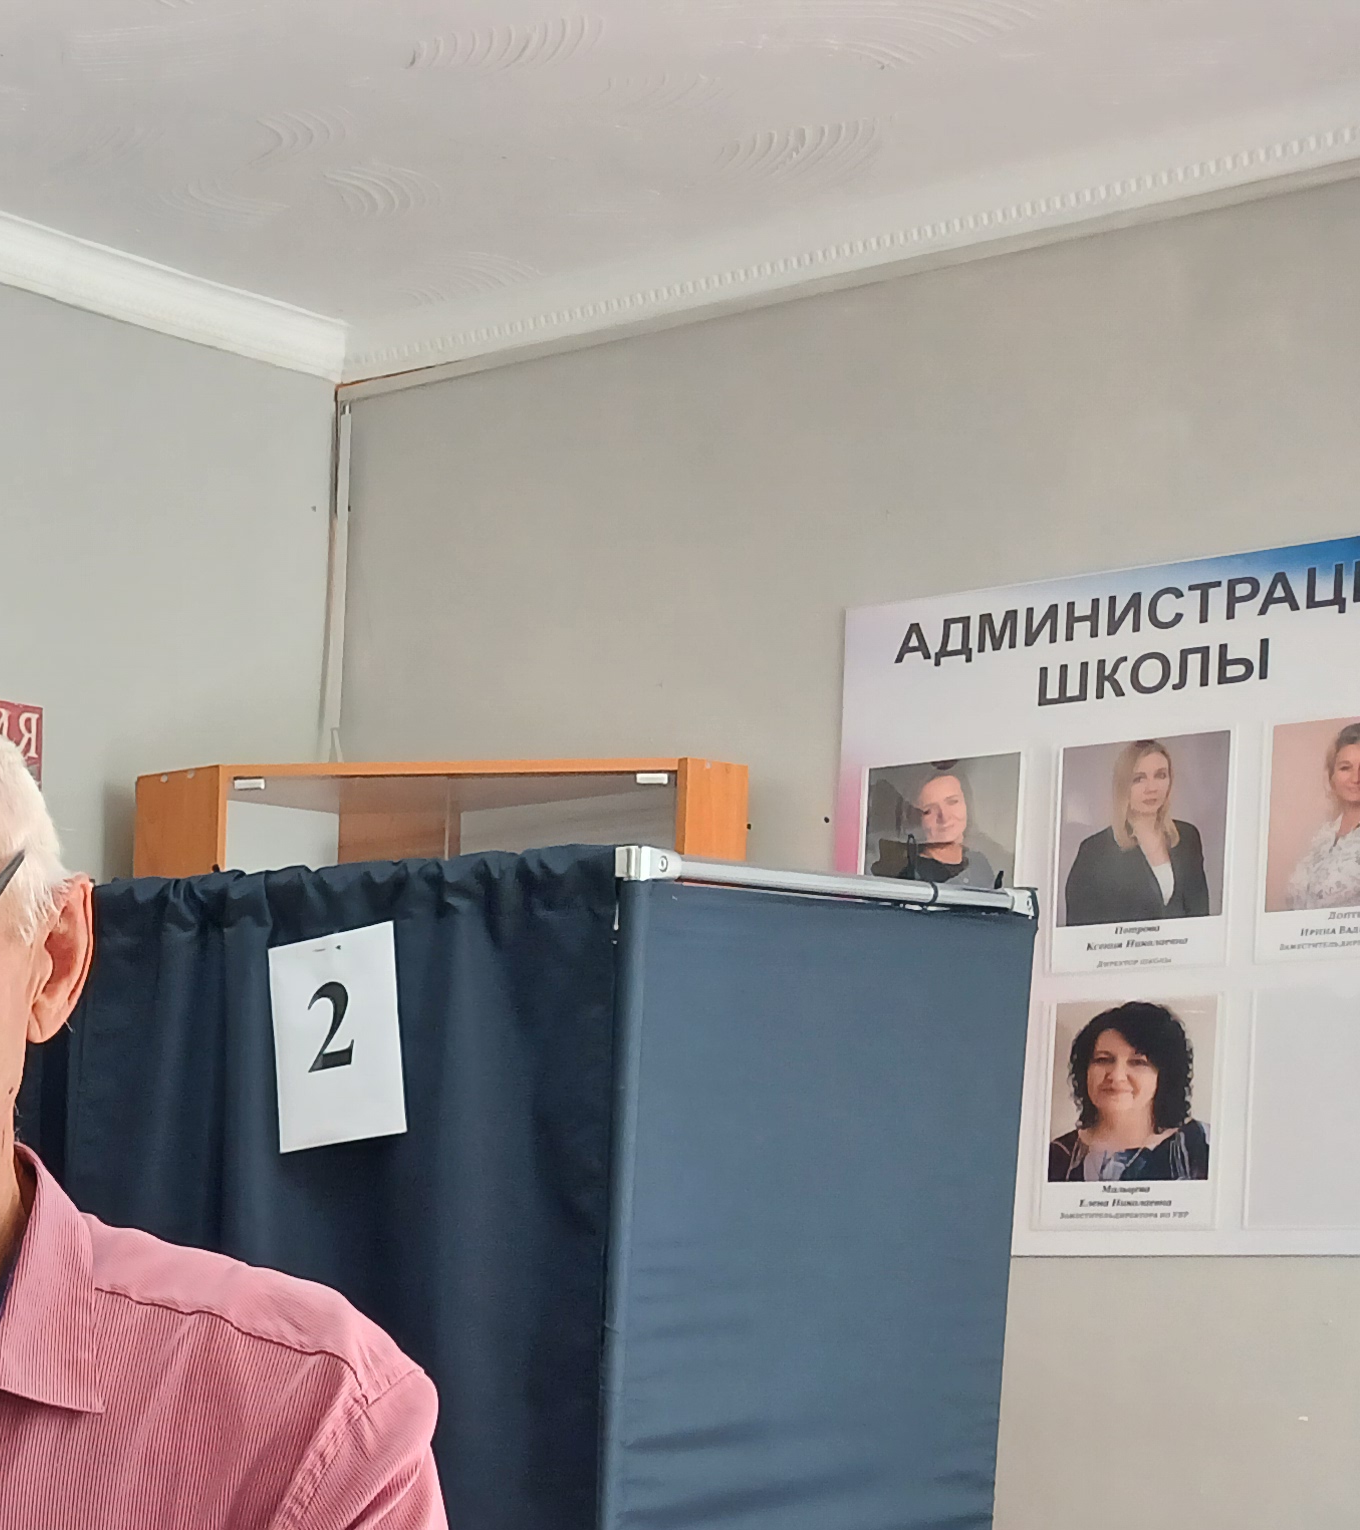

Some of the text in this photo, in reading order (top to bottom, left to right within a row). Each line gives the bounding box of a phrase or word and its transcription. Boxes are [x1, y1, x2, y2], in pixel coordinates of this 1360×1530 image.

[894, 560, 1360, 667] АДМИНИСТРАЦ
[1037, 638, 1270, 707] ШКОЛЫ
[308, 981, 354, 1073] 2
